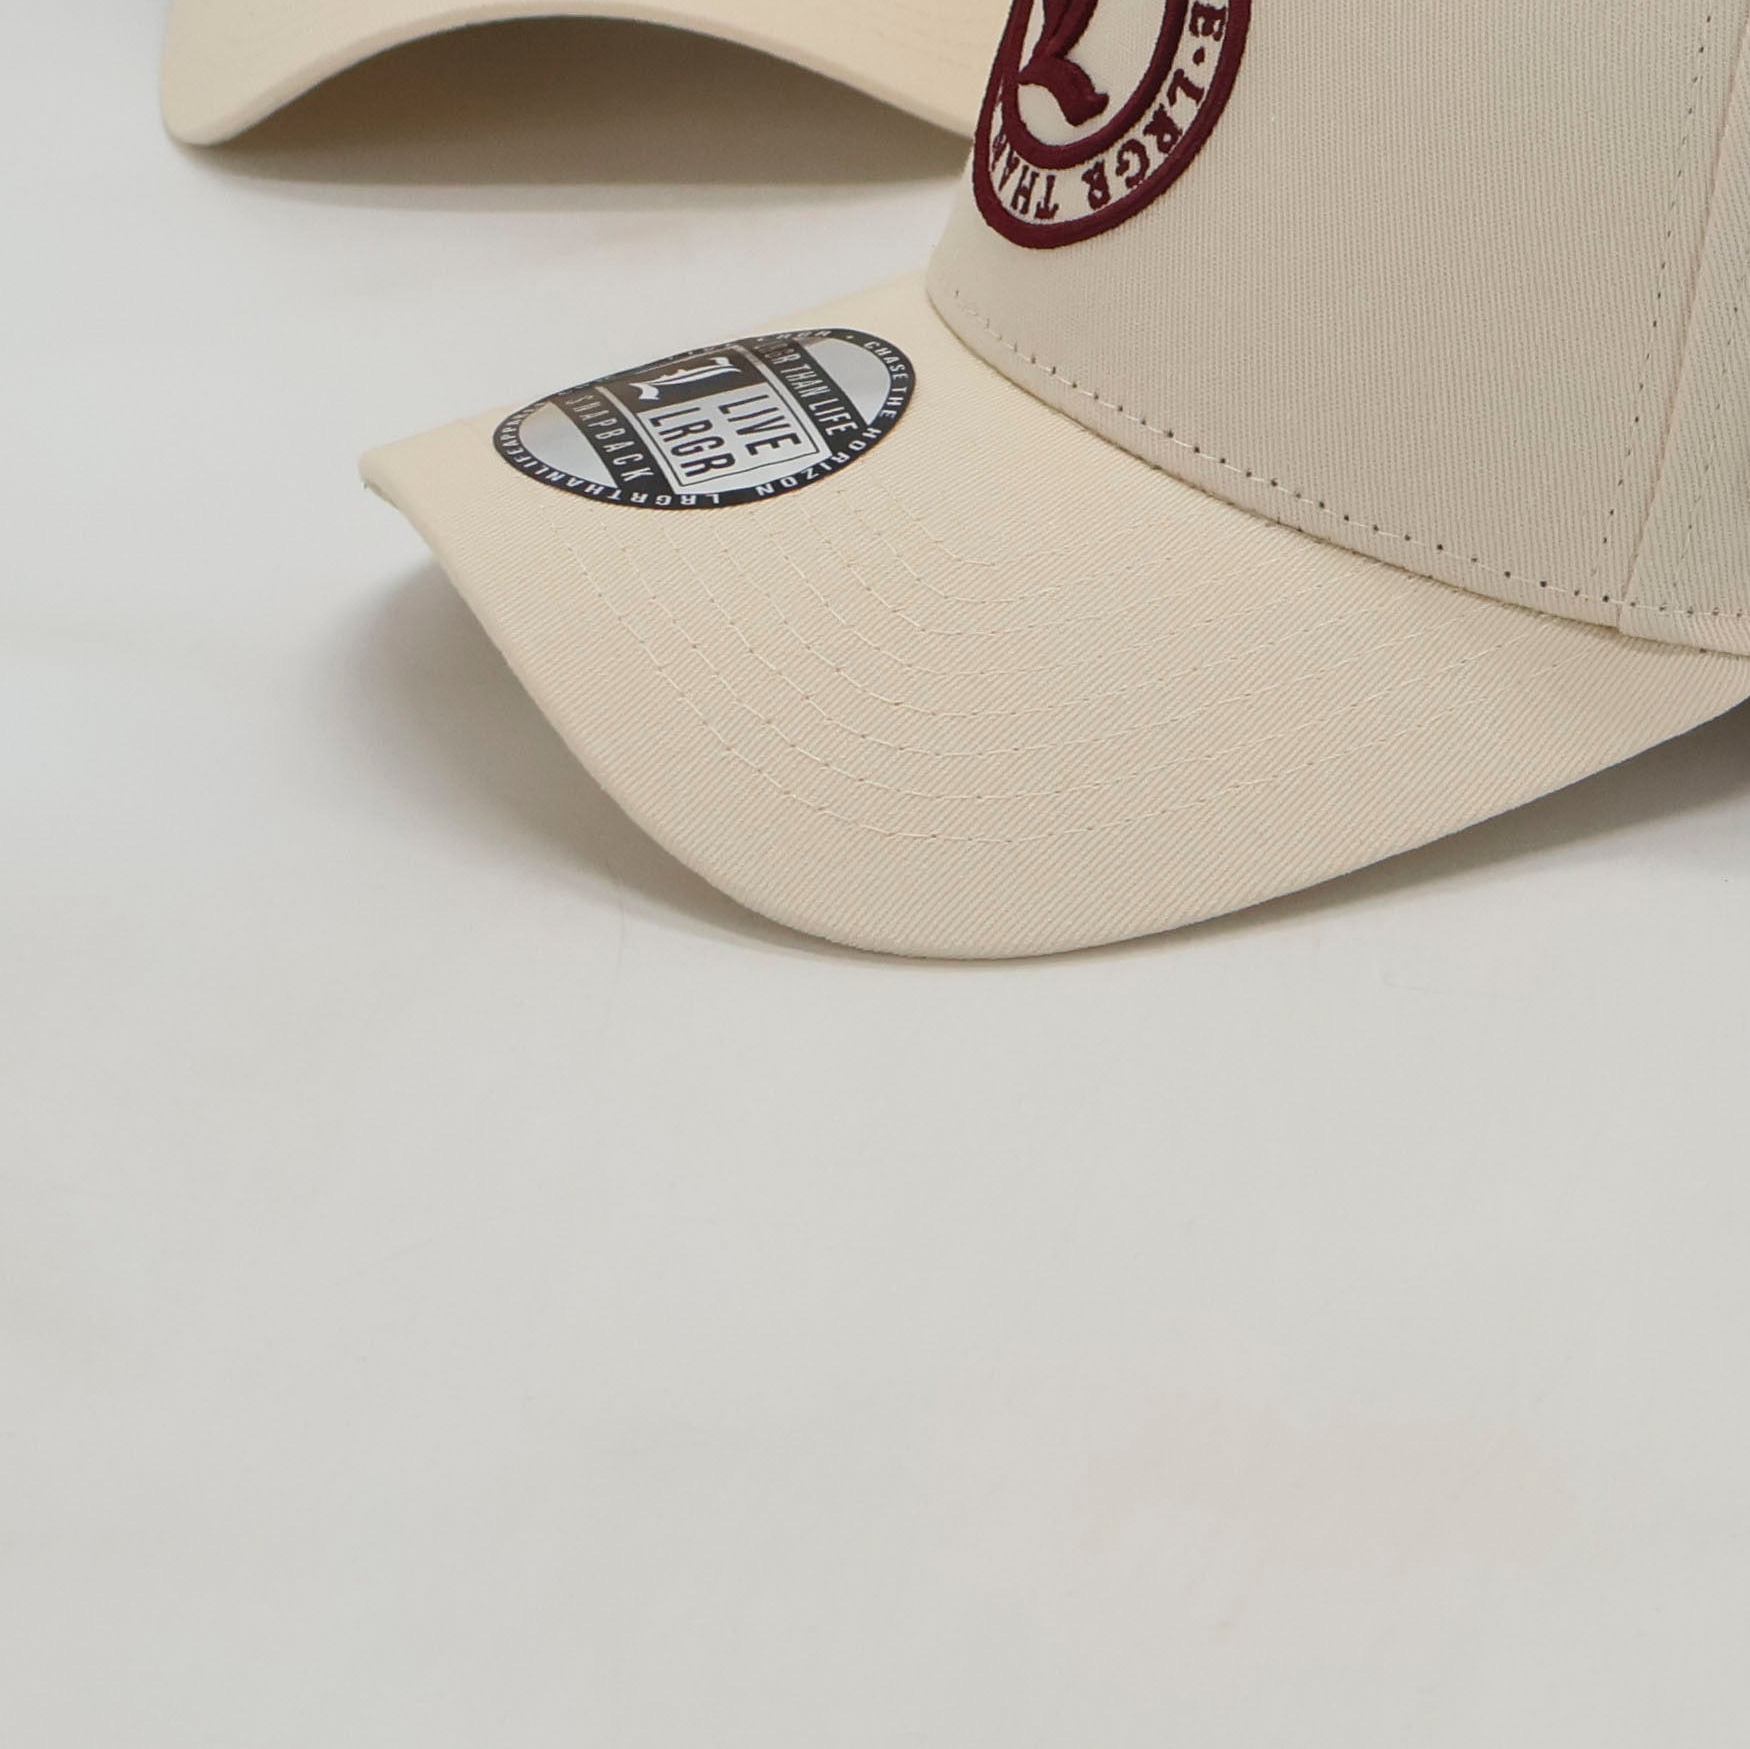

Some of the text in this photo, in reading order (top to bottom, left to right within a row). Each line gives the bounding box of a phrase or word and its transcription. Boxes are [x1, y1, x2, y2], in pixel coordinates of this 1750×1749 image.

[1081, 68, 1205, 211] LRGR
[629, 356, 742, 401] L
[781, 362, 831, 398] THAN
[808, 397, 858, 436] LIFE
[566, 394, 654, 482] SNAPBACK
[649, 406, 736, 478] LRGR
[718, 394, 802, 456] LIVE
[755, 340, 909, 496] CHASE THE HORIZON
